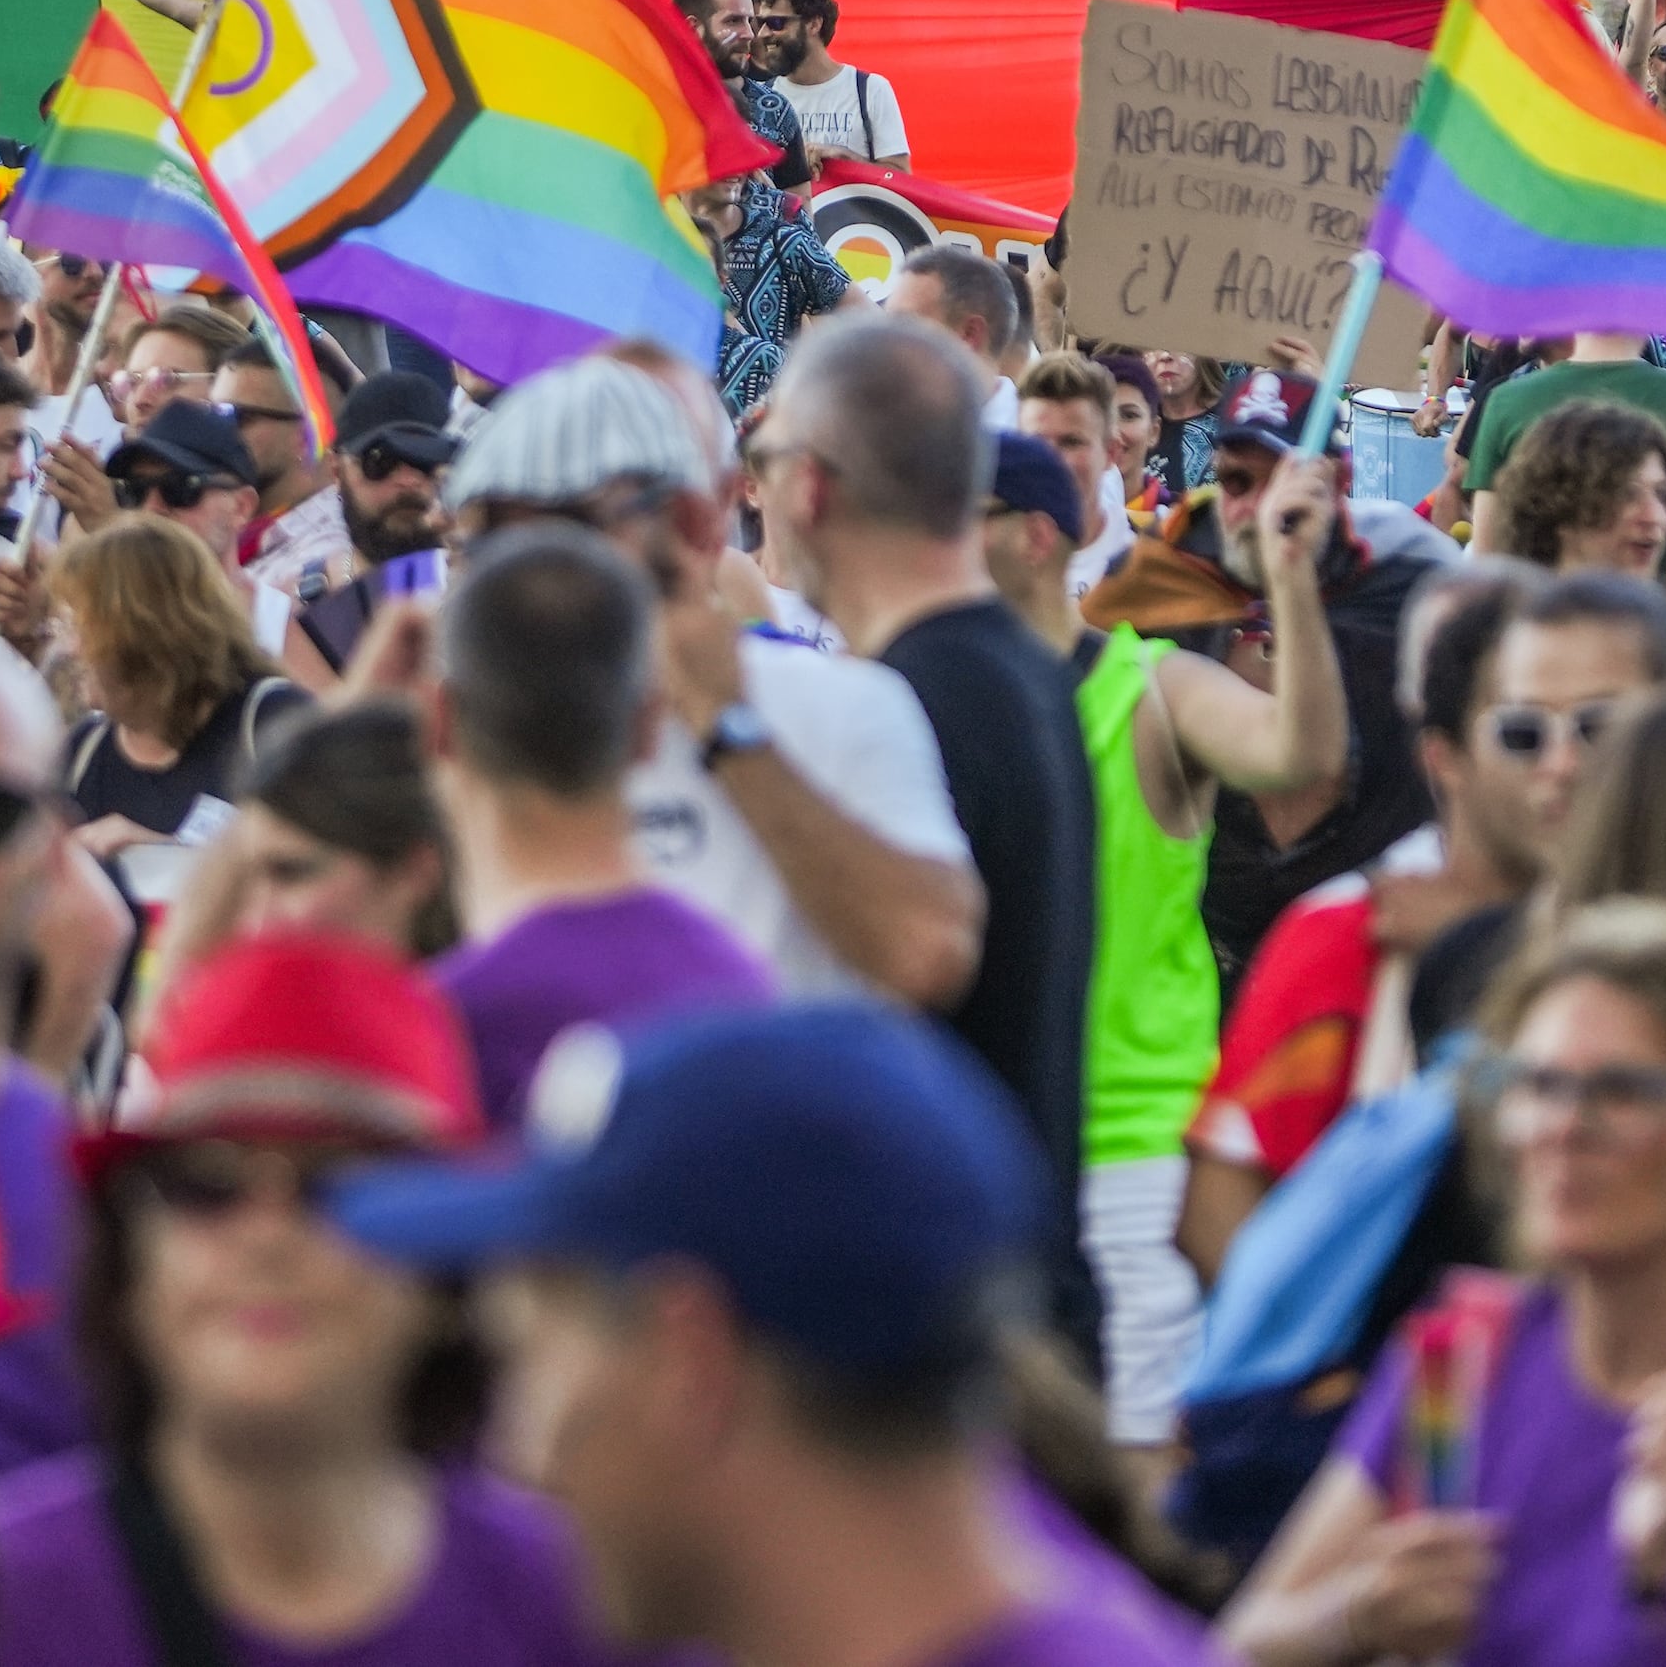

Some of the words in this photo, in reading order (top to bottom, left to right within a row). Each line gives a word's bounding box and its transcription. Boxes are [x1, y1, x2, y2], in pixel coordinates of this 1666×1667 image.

[1110, 22, 1252, 109] SOMOS
[1273, 49, 1423, 126] LESBIANA
[800, 112, 853, 133] ECTIVE
